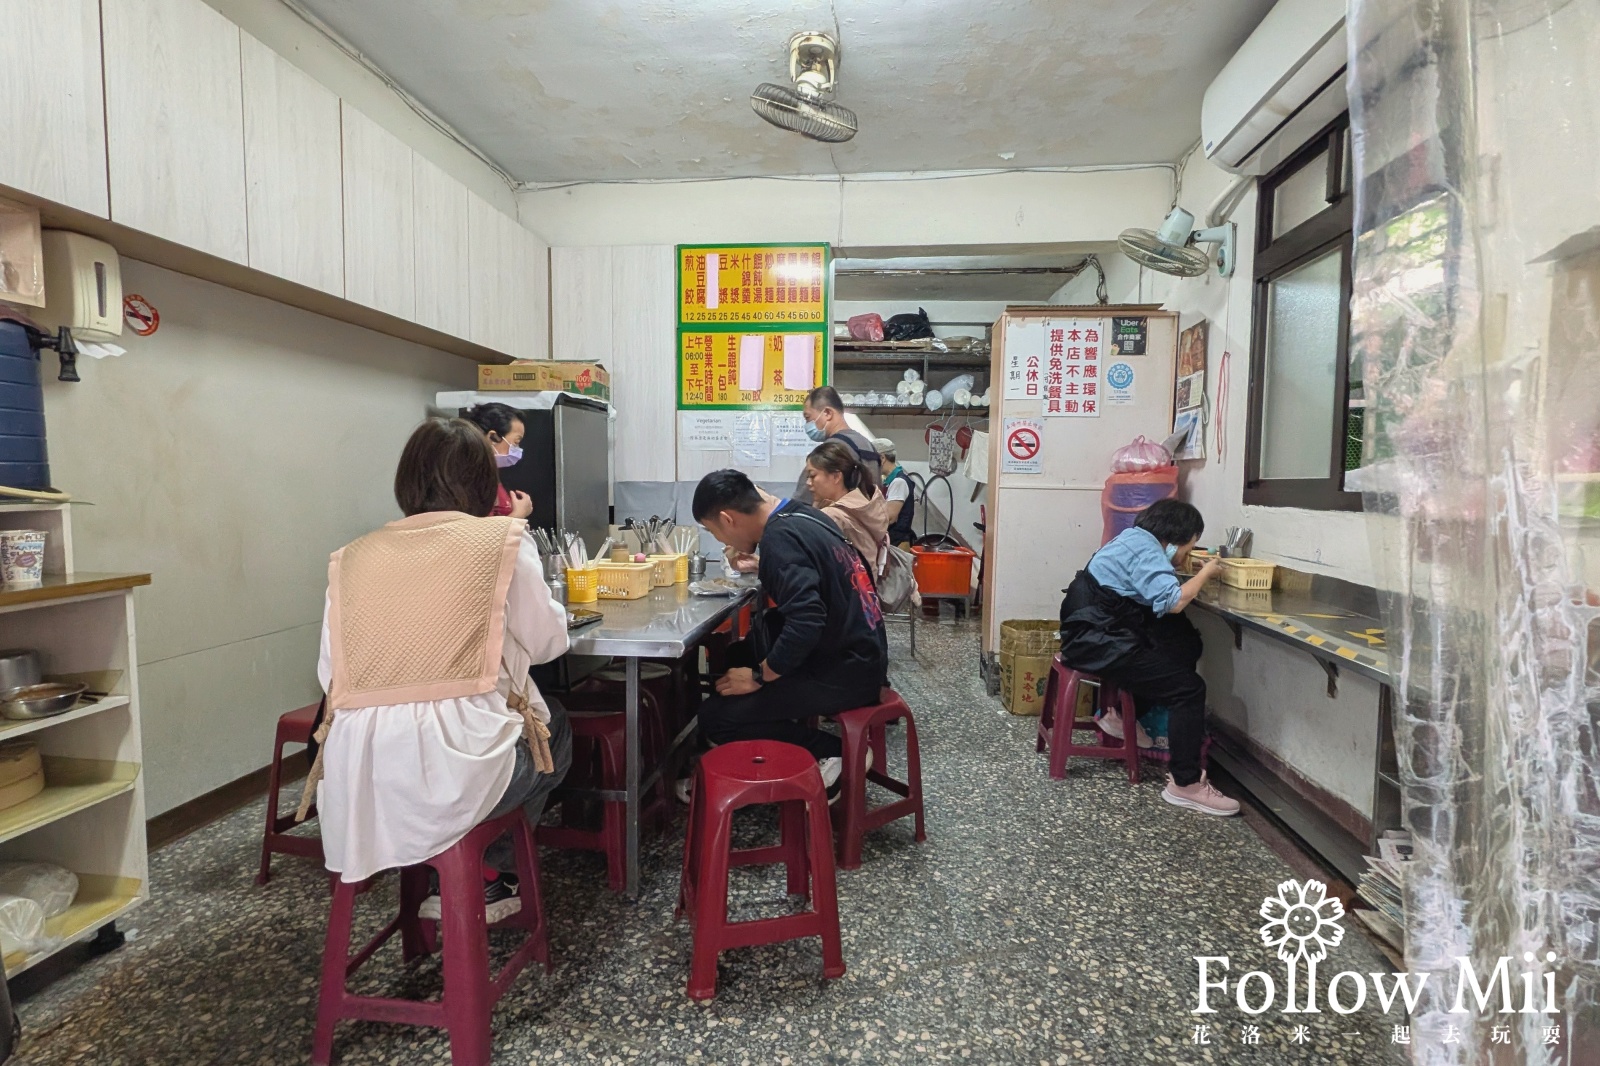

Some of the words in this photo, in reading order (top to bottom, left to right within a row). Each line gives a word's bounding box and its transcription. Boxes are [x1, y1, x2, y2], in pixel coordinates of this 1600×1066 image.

[696, 254, 705, 305] 油豆腐
[719, 254, 728, 304] 豆漿
[730, 254, 739, 304] 米漿
[686, 312, 694, 320] 12
[696, 312, 706, 320] 25
[708, 312, 716, 320] 25
[719, 312, 728, 320] 25
[730, 312, 740, 320] 25
[776, 312, 785, 320] 45
[788, 312, 797, 320] 45
[811, 312, 820, 320] 60
[686, 336, 703, 349] 上午
[686, 352, 704, 360] 06:00
[774, 336, 782, 386] 奶茶
[686, 378, 704, 391] 下午
[690, 364, 698, 376] 至
[704, 336, 713, 402] 營業時間
[718, 364, 726, 391] 一包
[1026, 356, 1039, 396] 公休日
[1048, 329, 1064, 413] 提供免洗餐具
[1065, 329, 1081, 413] 本店不主動
[1082, 329, 1098, 413] 為響應環保
[686, 392, 704, 400] 12:40
[774, 394, 782, 402] 25
[784, 394, 794, 402] 30
